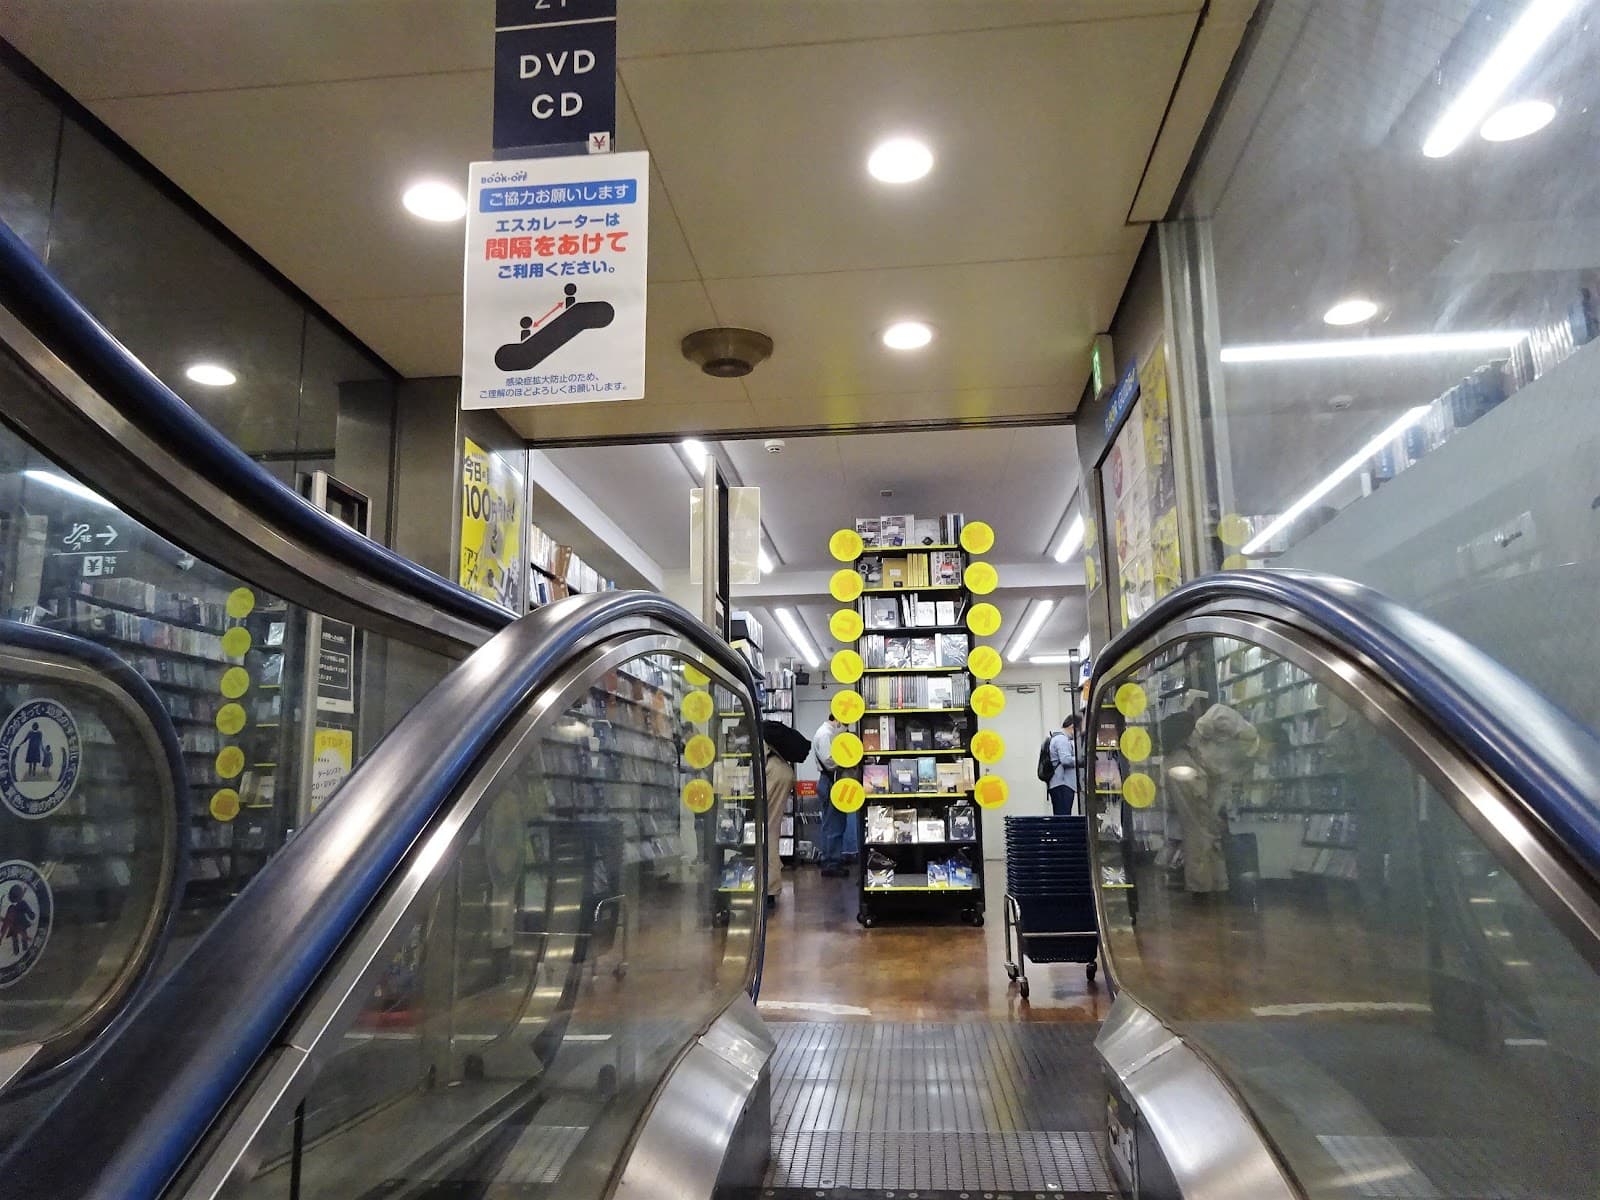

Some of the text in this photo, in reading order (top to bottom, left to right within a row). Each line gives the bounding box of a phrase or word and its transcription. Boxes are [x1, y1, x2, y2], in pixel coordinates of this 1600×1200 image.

[519, 49, 596, 79] DVD
[531, 91, 583, 119] CD
[489, 184, 629, 207] ご協力お願いします
[496, 213, 620, 233] エスカレーターは
[485, 232, 629, 261] 間隔をあけて
[498, 260, 616, 280] ご利用ください。
[479, 382, 628, 399] ご理解のほどよろしくお願いします。
[505, 373, 600, 387] 感染症拡大防止のため、
